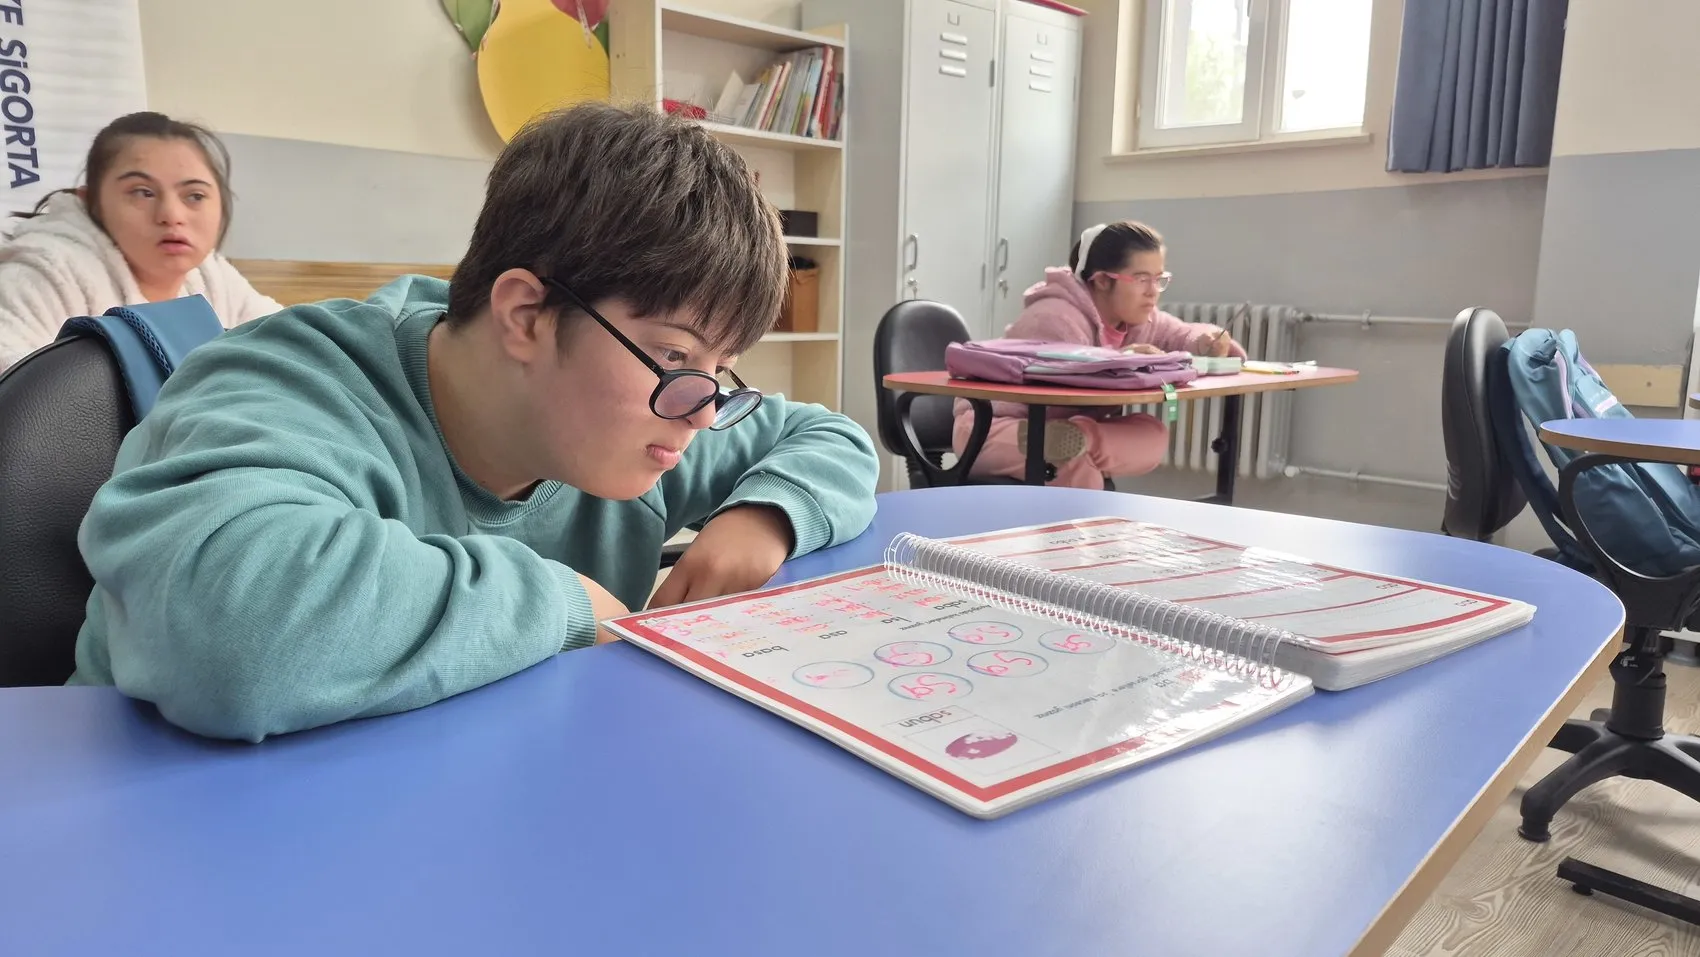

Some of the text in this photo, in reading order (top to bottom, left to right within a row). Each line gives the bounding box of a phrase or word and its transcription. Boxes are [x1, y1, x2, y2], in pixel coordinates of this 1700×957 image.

[818, 630, 848, 640] asa
[741, 644, 790, 659] basa
[898, 708, 952, 729] sabun
